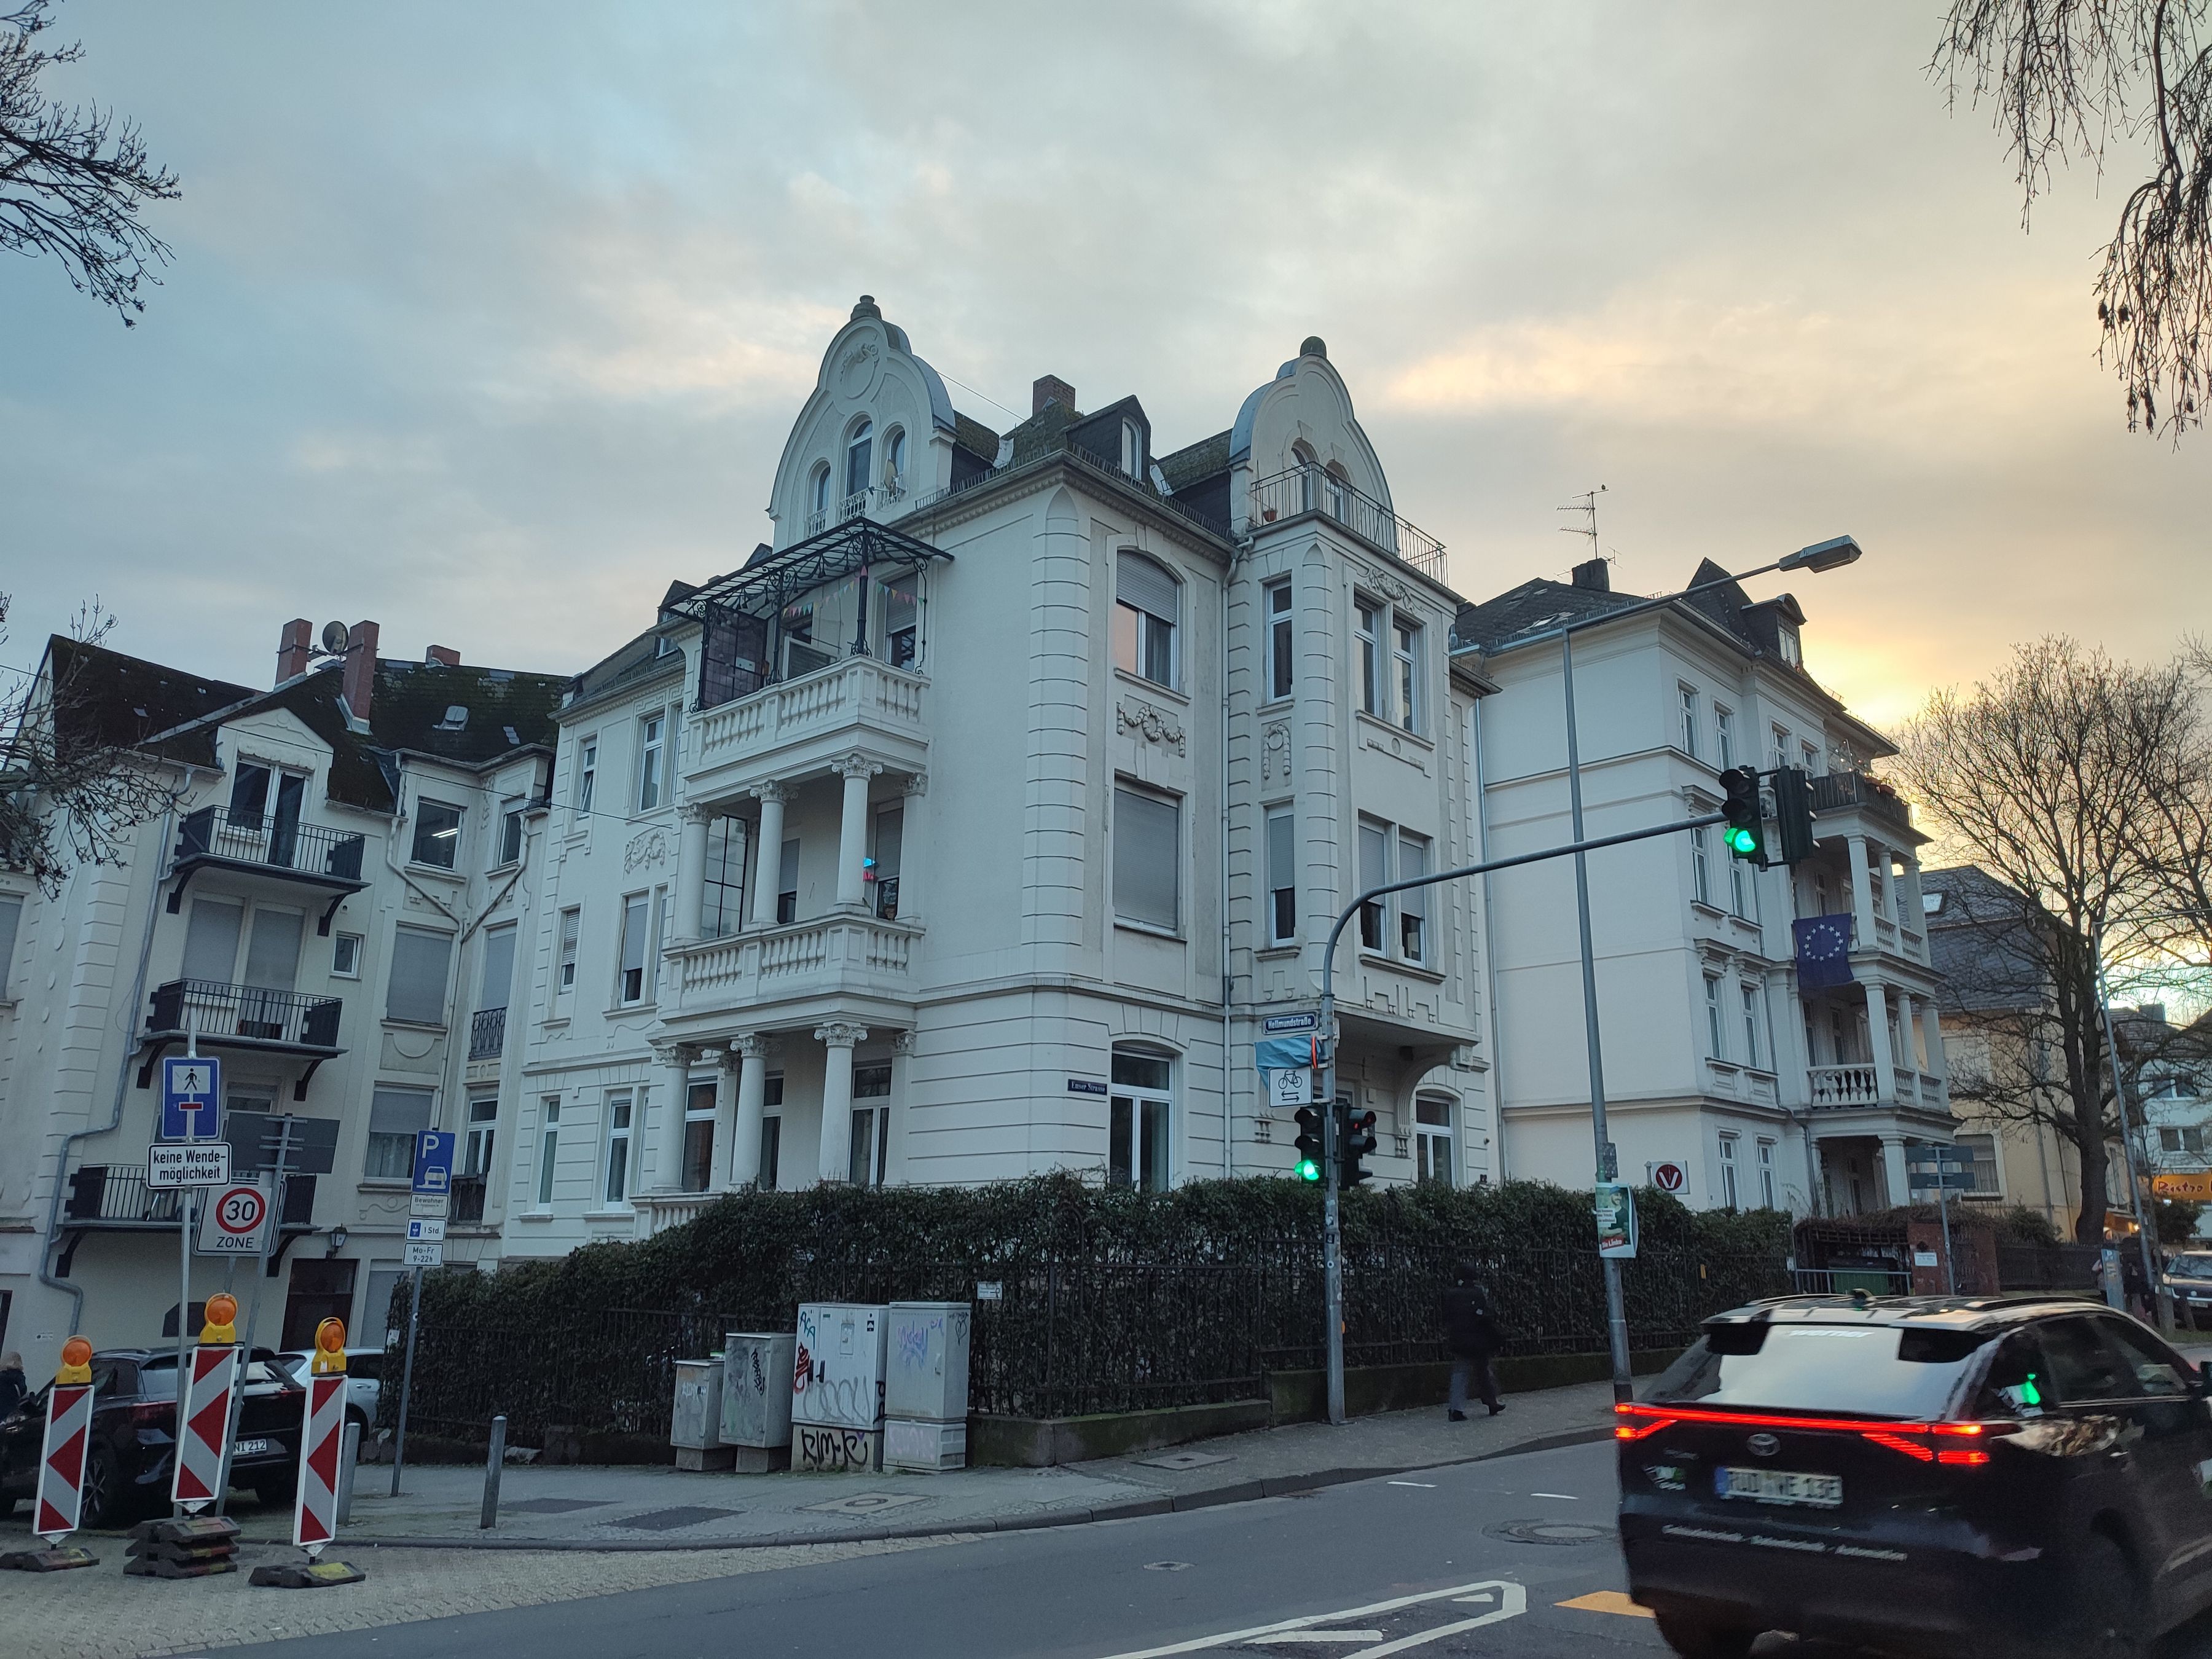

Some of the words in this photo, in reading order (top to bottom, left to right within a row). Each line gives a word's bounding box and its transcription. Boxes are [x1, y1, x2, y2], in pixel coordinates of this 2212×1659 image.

[1268, 1017, 1311, 1029] Hellmundstraße
[422, 1134, 439, 1158] P
[154, 1150, 182, 1164] keine
[186, 1150, 226, 1163] Wende-
[160, 1166, 221, 1183] möglichkeit
[226, 1201, 255, 1221] 30
[216, 1237, 254, 1248] ZONE
[248, 1440, 266, 1451] 212
